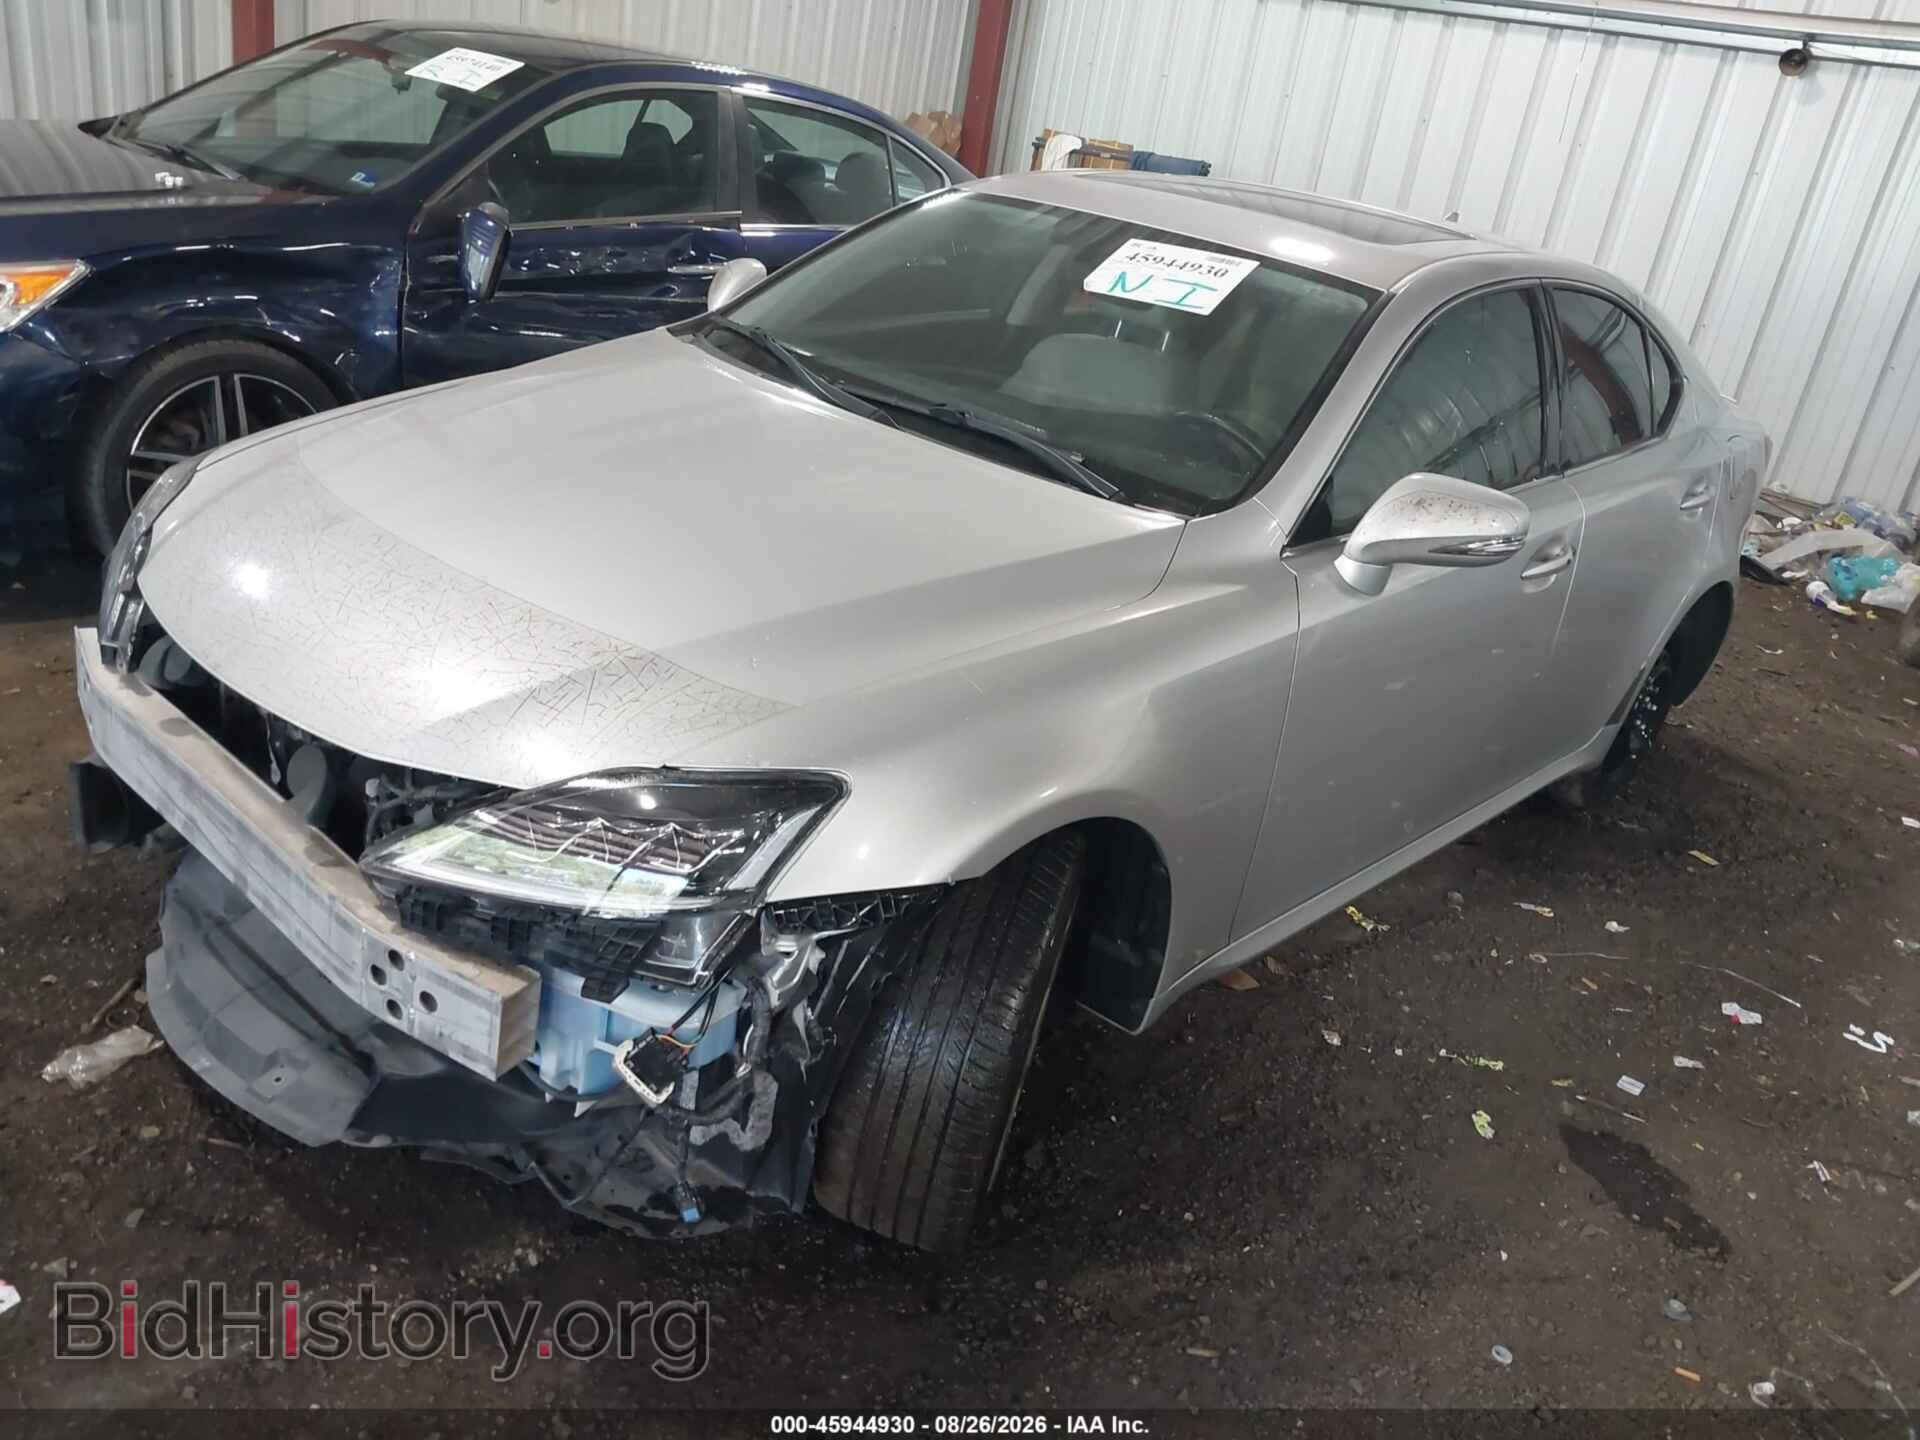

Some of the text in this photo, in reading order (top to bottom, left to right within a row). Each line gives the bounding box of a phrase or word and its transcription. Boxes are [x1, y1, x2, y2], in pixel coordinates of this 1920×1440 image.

[1126, 252, 1230, 279] 45944930
[1107, 270, 1218, 309] N I
